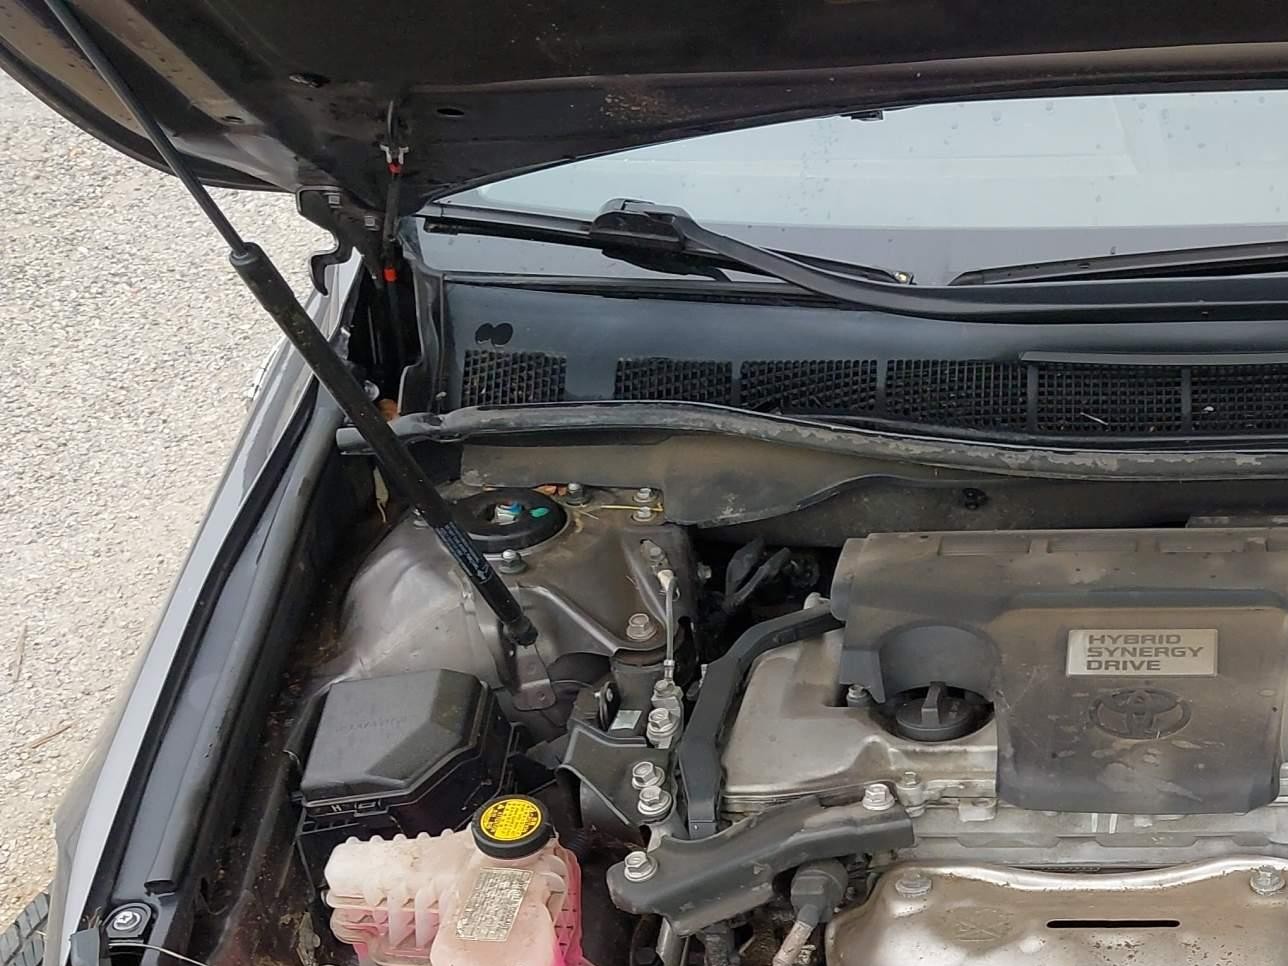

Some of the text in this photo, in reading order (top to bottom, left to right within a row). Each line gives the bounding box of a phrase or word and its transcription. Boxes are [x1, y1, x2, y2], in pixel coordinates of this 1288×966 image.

[1088, 634, 1182, 645] HYBRID
[1087, 646, 1204, 658] SYNERGY
[1086, 660, 1161, 671] DRIVE
